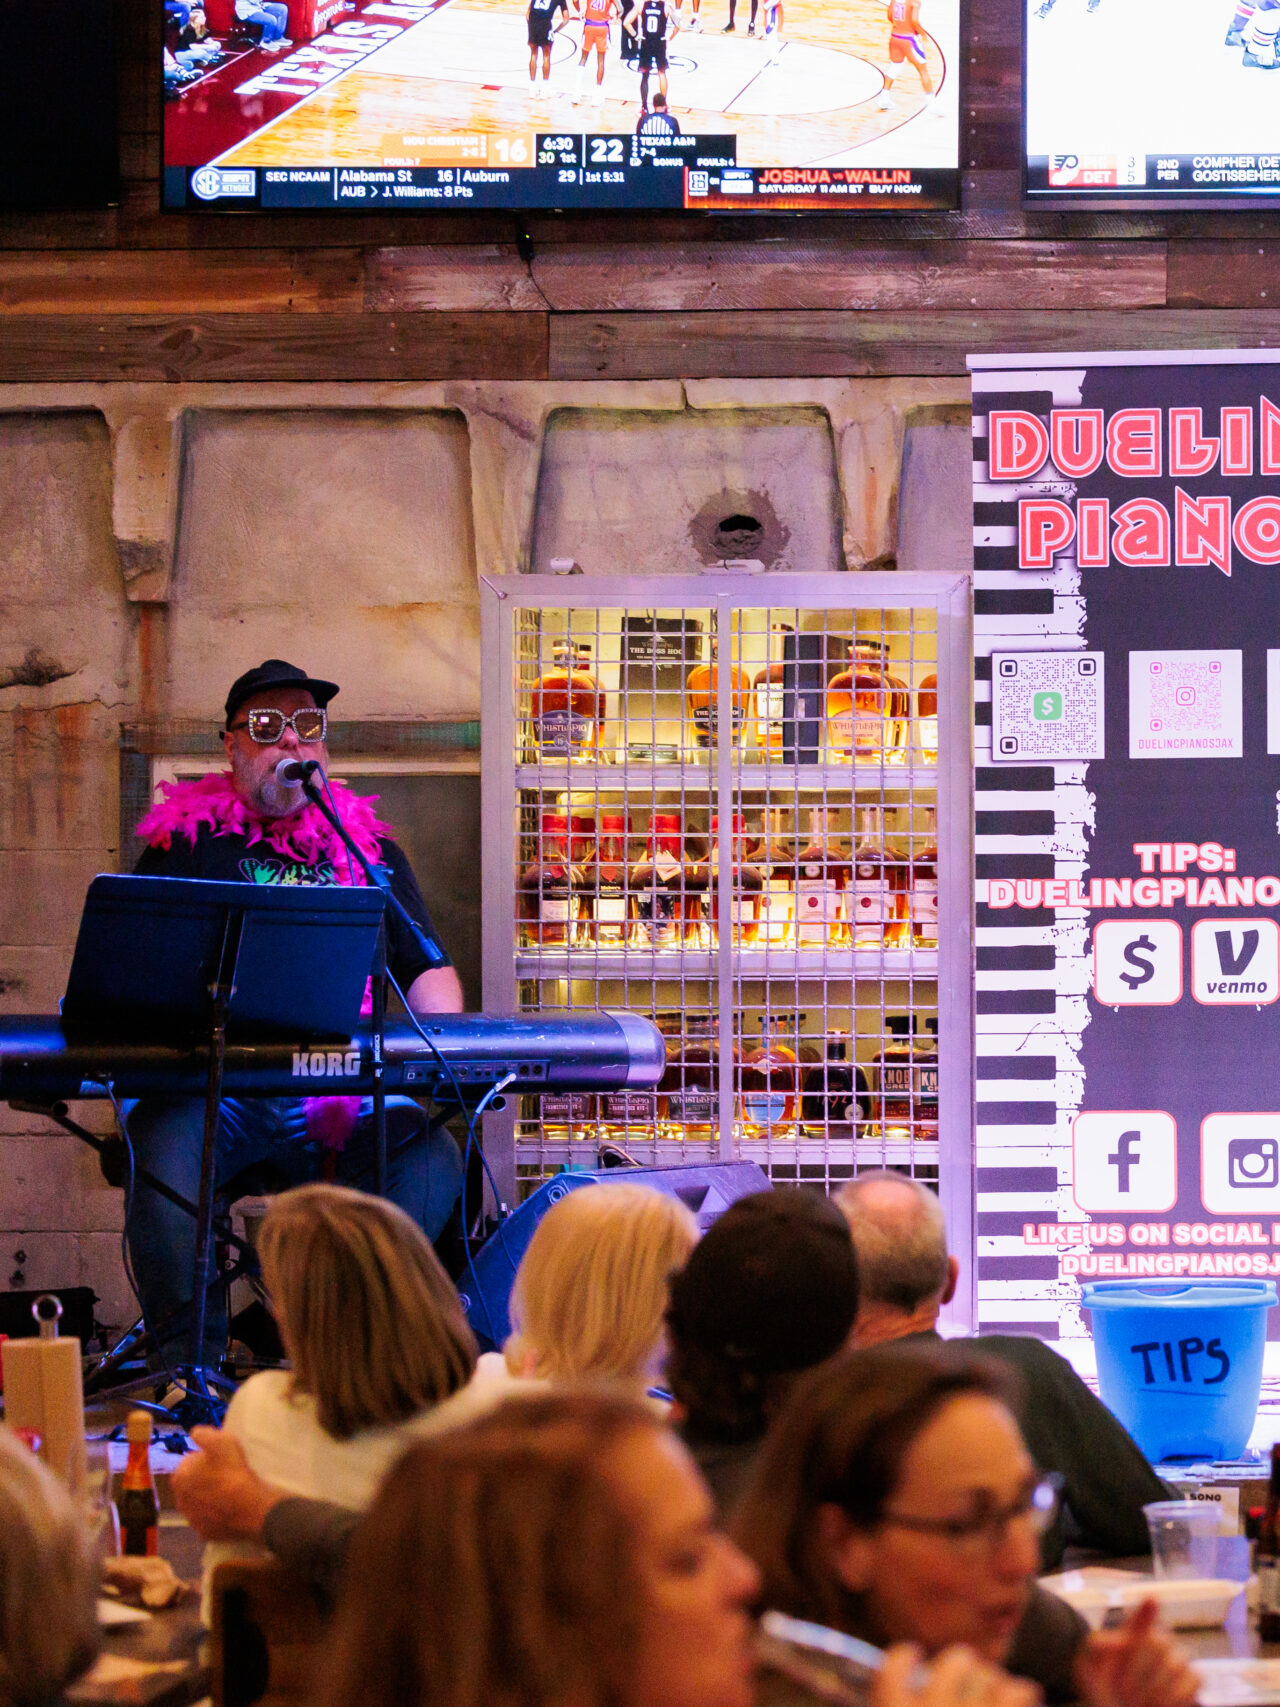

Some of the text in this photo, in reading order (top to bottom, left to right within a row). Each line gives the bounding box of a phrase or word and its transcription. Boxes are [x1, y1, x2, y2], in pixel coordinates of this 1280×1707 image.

[543, 137, 574, 150] 6:30
[640, 137, 670, 146] TEXAS
[495, 138, 528, 163] 16
[590, 139, 624, 162] 22
[538, 152, 576, 163] 30 1st
[653, 158, 684, 166] BONUS
[1193, 156, 1255, 168] COMPHER
[1157, 159, 1179, 169] 2ND
[265, 171, 331, 182] SEC NCAAM
[340, 170, 453, 183] Alabama St 16
[463, 170, 577, 183] Auburn 29
[585, 172, 625, 183] 1st 5:31
[759, 170, 831, 183] JOSHUA
[844, 170, 911, 183] WALLIN
[1083, 170, 1112, 183] DET
[1157, 170, 1179, 180] PER
[341, 186, 366, 198] AUB
[444, 186, 453, 198] 8
[454, 186, 474, 198] Pts
[759, 185, 816, 194] SATURDAY
[829, 185, 848, 193] AM
[849, 185, 863, 193] ET
[869, 185, 892, 194] BUY
[894, 185, 923, 194] NOW
[1138, 738, 1234, 750] DUELINGPIANOSJAX
[1133, 843, 1236, 872] TIPS:
[1206, 980, 1268, 994] venmo
[292, 1052, 361, 1077] KORG
[921, 1073, 938, 1085] KN
[1024, 1224, 1085, 1245] LIKE
[1088, 1224, 1126, 1245] US
[1129, 1224, 1168, 1244] ON
[1172, 1223, 1270, 1244] SOCIAL
[1131, 1337, 1231, 1386] TIPS
